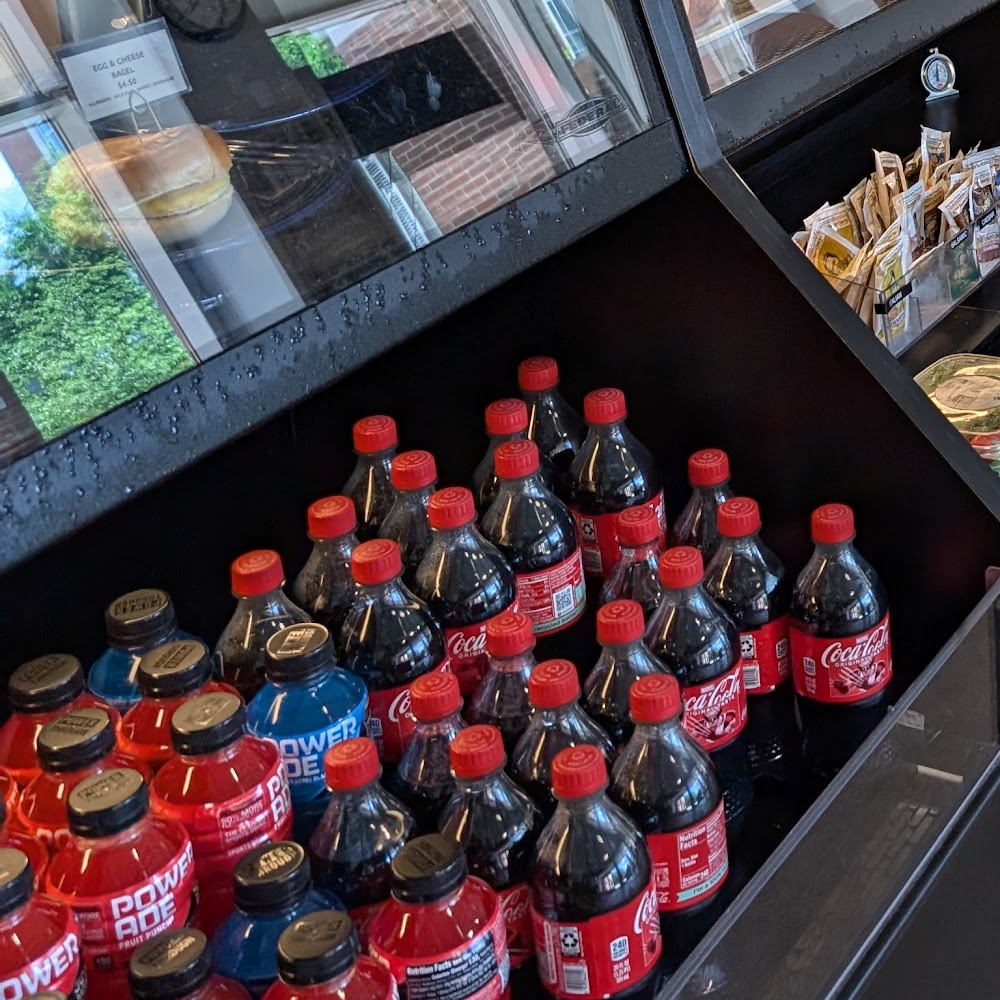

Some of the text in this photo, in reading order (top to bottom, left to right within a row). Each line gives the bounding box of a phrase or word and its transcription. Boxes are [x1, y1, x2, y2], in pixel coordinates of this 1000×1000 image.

[93, 62, 108, 73] EGG
[116, 50, 145, 65] CHEESE
[111, 67, 135, 79] BAGEL
[117, 77, 137, 90] $4.50
[680, 826, 706, 842] Nutrition
[680, 838, 698, 850] Facts
[111, 841, 193, 919] POWER
[114, 891, 177, 941] ADE
[119, 914, 175, 950] FRUIT PUNCH
[612, 937, 628, 951] 240
[0, 932, 79, 1000] OWER
